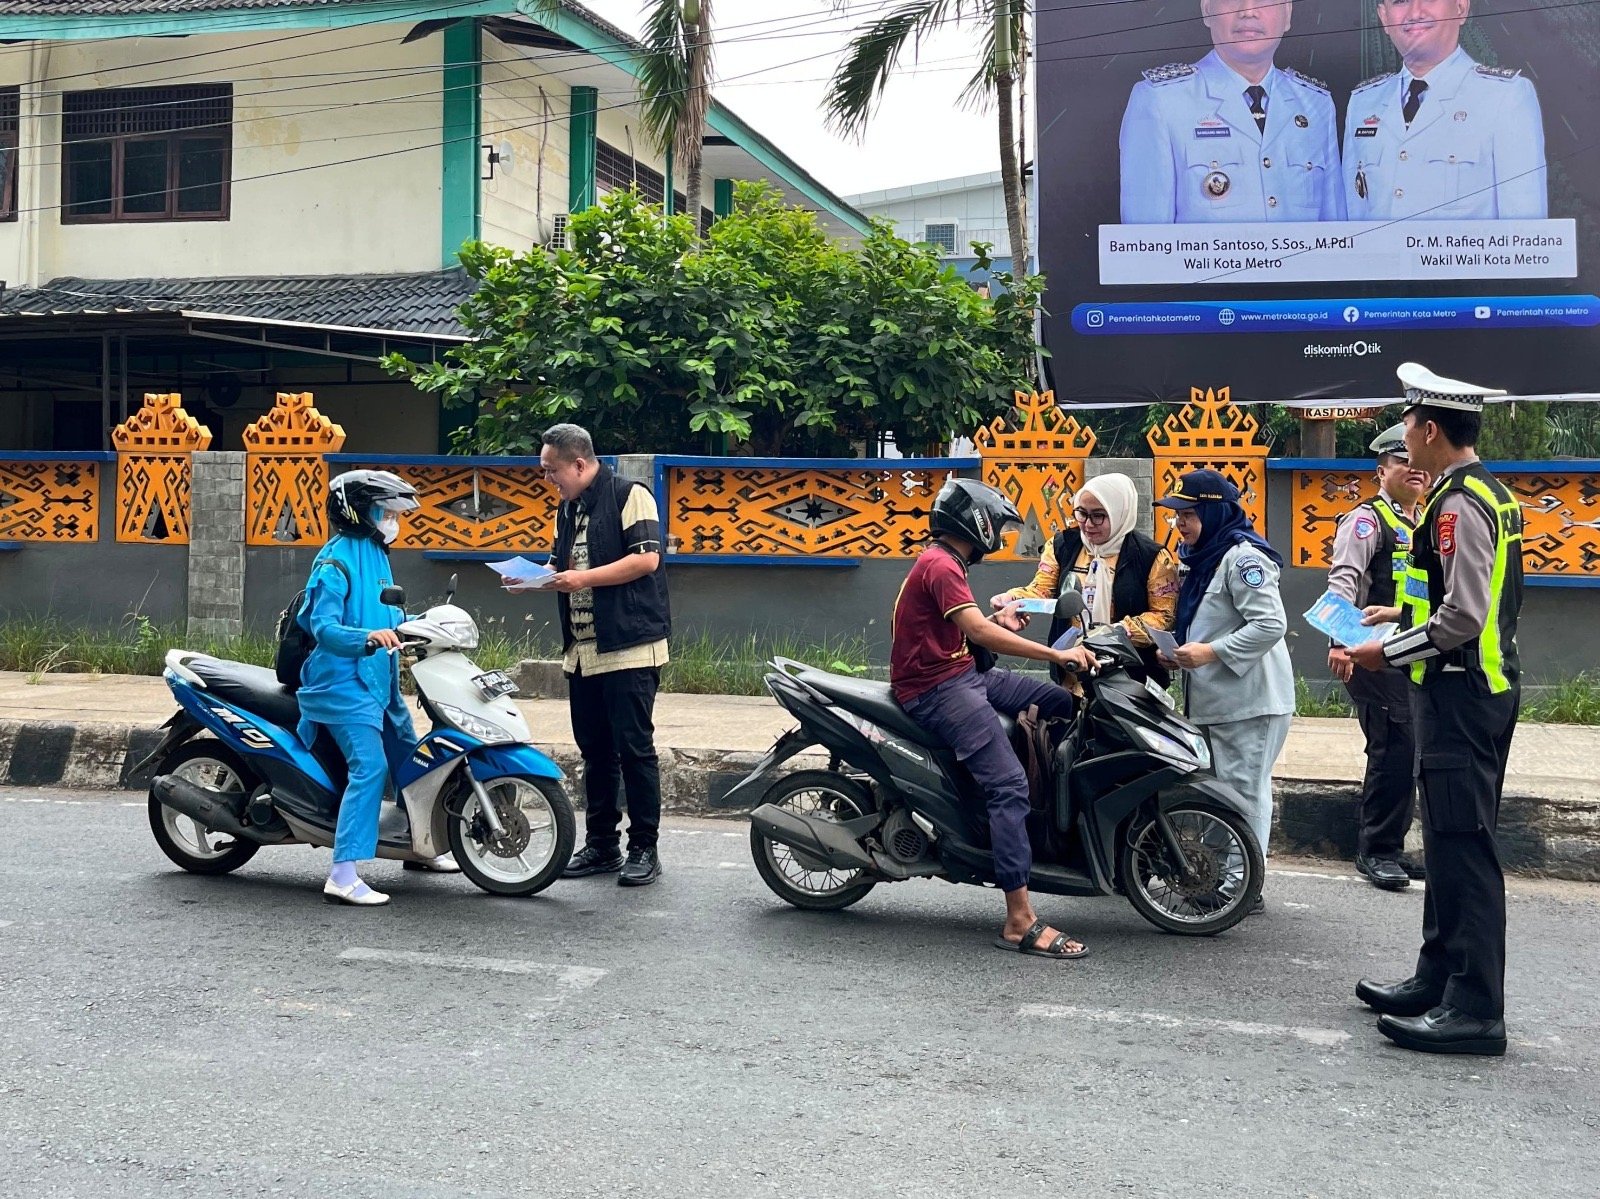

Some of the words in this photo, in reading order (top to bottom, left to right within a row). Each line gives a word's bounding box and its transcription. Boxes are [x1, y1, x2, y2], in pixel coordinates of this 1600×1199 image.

[1110, 241, 1172, 254] Bambang
[1176, 240, 1208, 251] Iman
[1213, 239, 1267, 252] Santoso,
[1272, 238, 1312, 251] S.Sos.,
[1315, 237, 1353, 249] M.Pd.I
[1406, 236, 1423, 248] Dr.
[1427, 236, 1442, 247] M.
[1446, 235, 1484, 249] Rafieq
[1488, 235, 1509, 246] Adi
[1512, 235, 1562, 246] Pradana
[1183, 257, 1210, 270] Wali
[1214, 257, 1241, 269] Kota
[1245, 257, 1282, 269] Metro
[1420, 254, 1452, 266] Wakil
[1455, 254, 1480, 265] Wali
[1484, 253, 1511, 265] Kota
[1514, 253, 1549, 265] Metro
[1240, 311, 1328, 322] www.metrokota.go.id
[1364, 310, 1411, 319] Pemerintah
[1412, 309, 1431, 318] Kota
[1432, 309, 1457, 318] Metro
[1496, 308, 1543, 317] Pemerintah
[1544, 307, 1564, 316] Kota
[1565, 306, 1589, 316] Metro
[1108, 314, 1201, 323] Pemerintahkotametro
